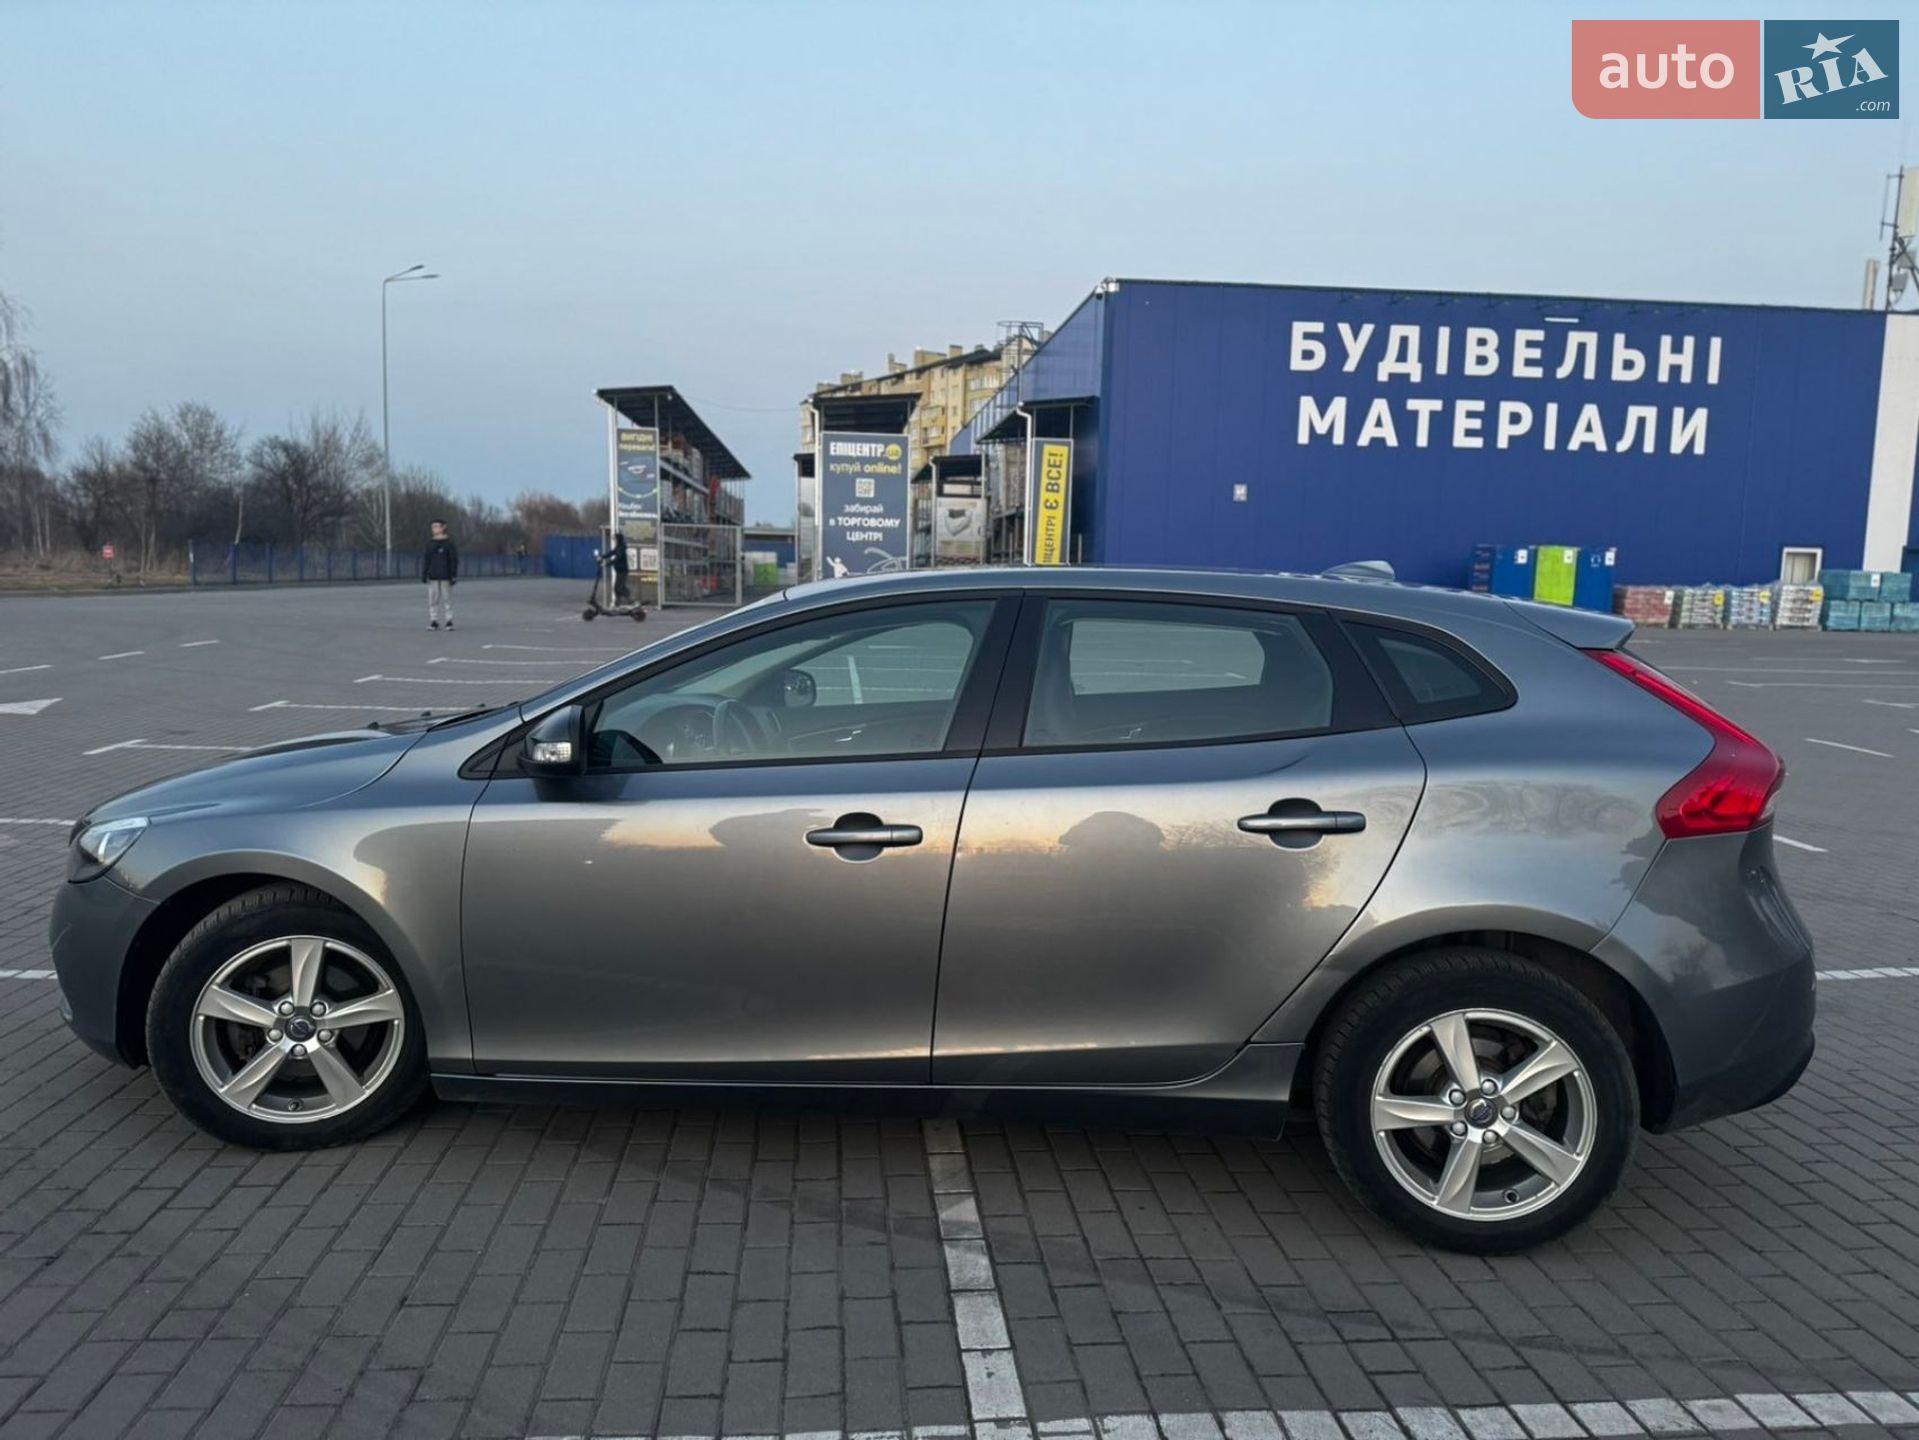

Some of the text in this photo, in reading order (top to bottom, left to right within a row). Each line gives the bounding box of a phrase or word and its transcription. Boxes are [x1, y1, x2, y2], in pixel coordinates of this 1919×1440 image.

[1289, 321, 1723, 385] БУДІВЕЛЬНІ
[1296, 395, 1709, 456] МАТЕРІАЛИ
[837, 516, 901, 528] ТОРГОВОМУ
[846, 531, 884, 542] ЦЕНТРІ
